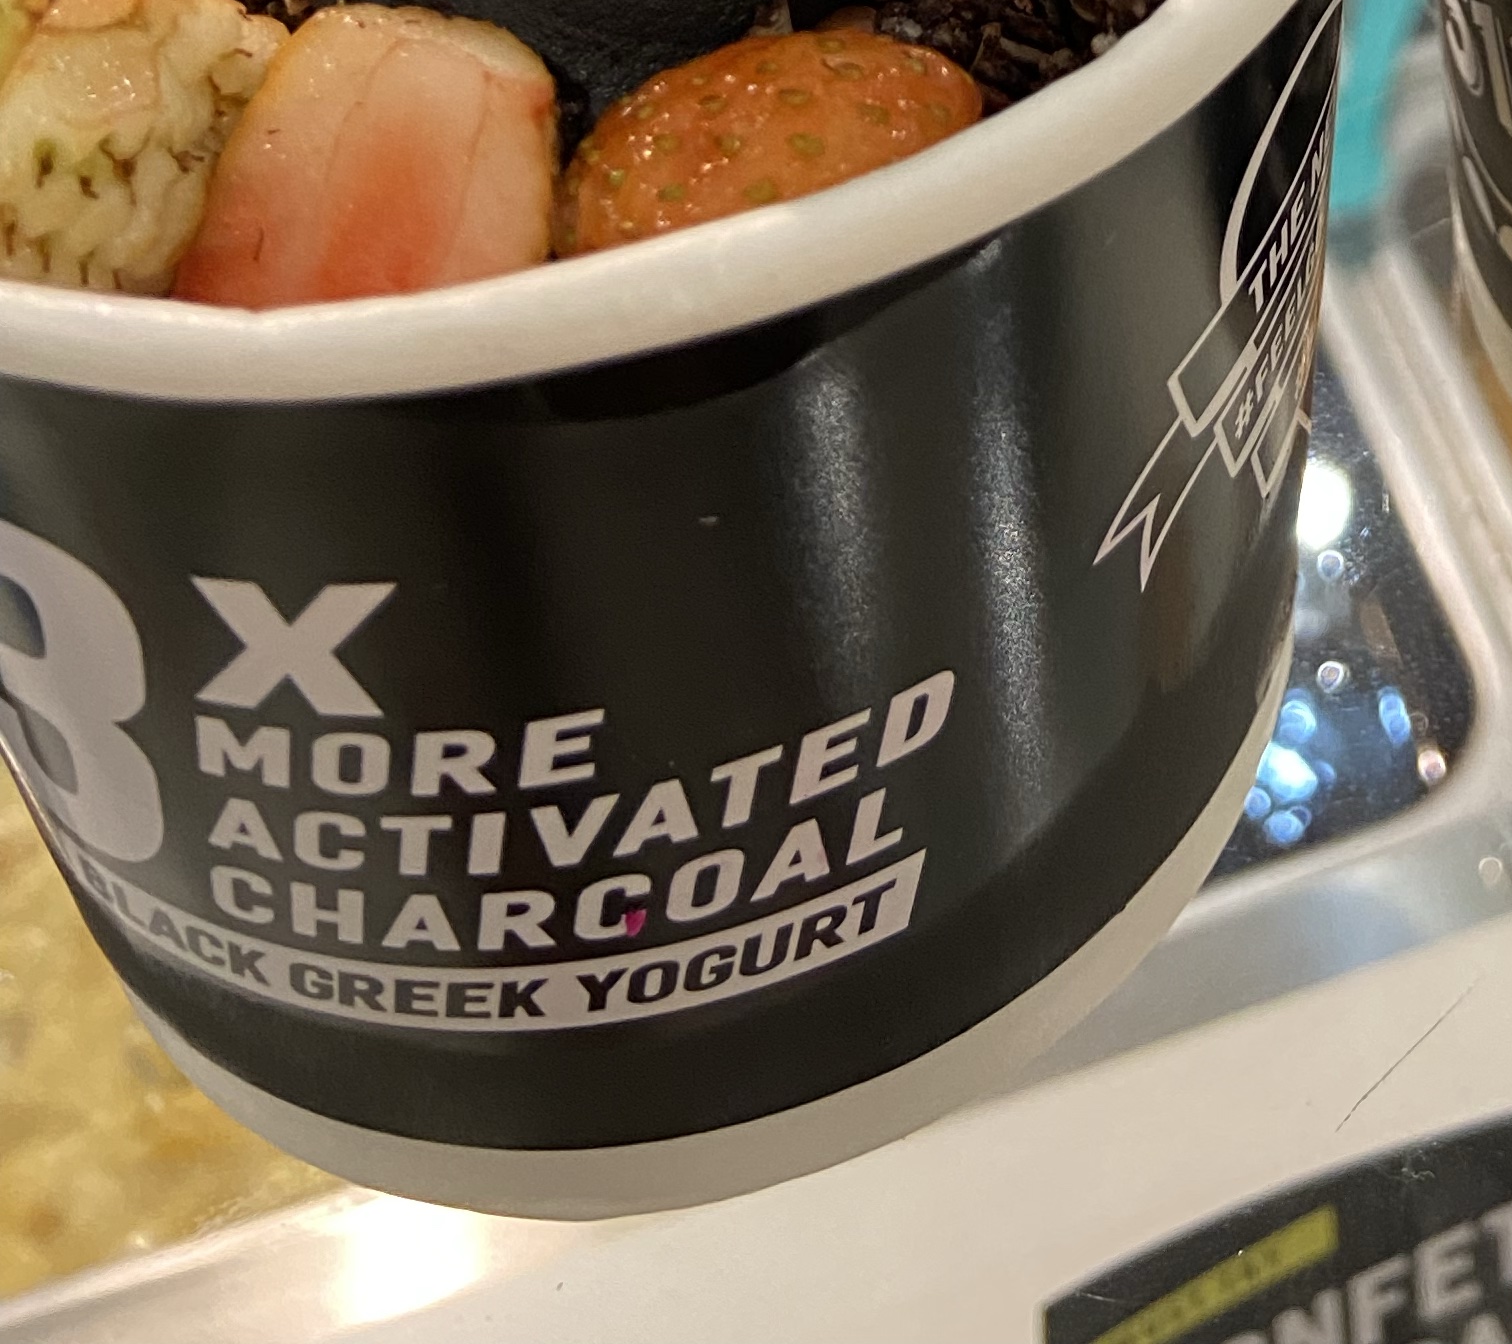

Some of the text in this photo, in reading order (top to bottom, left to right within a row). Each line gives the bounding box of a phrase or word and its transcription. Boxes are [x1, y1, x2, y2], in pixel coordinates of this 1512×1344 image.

[1249, 180, 1306, 313] THE
[194, 709, 605, 798] MORE
[208, 669, 955, 877] ACTIVATED
[77, 849, 901, 1019] BLACK GREEK YOGURT
[209, 789, 904, 954] CHARCOAL
